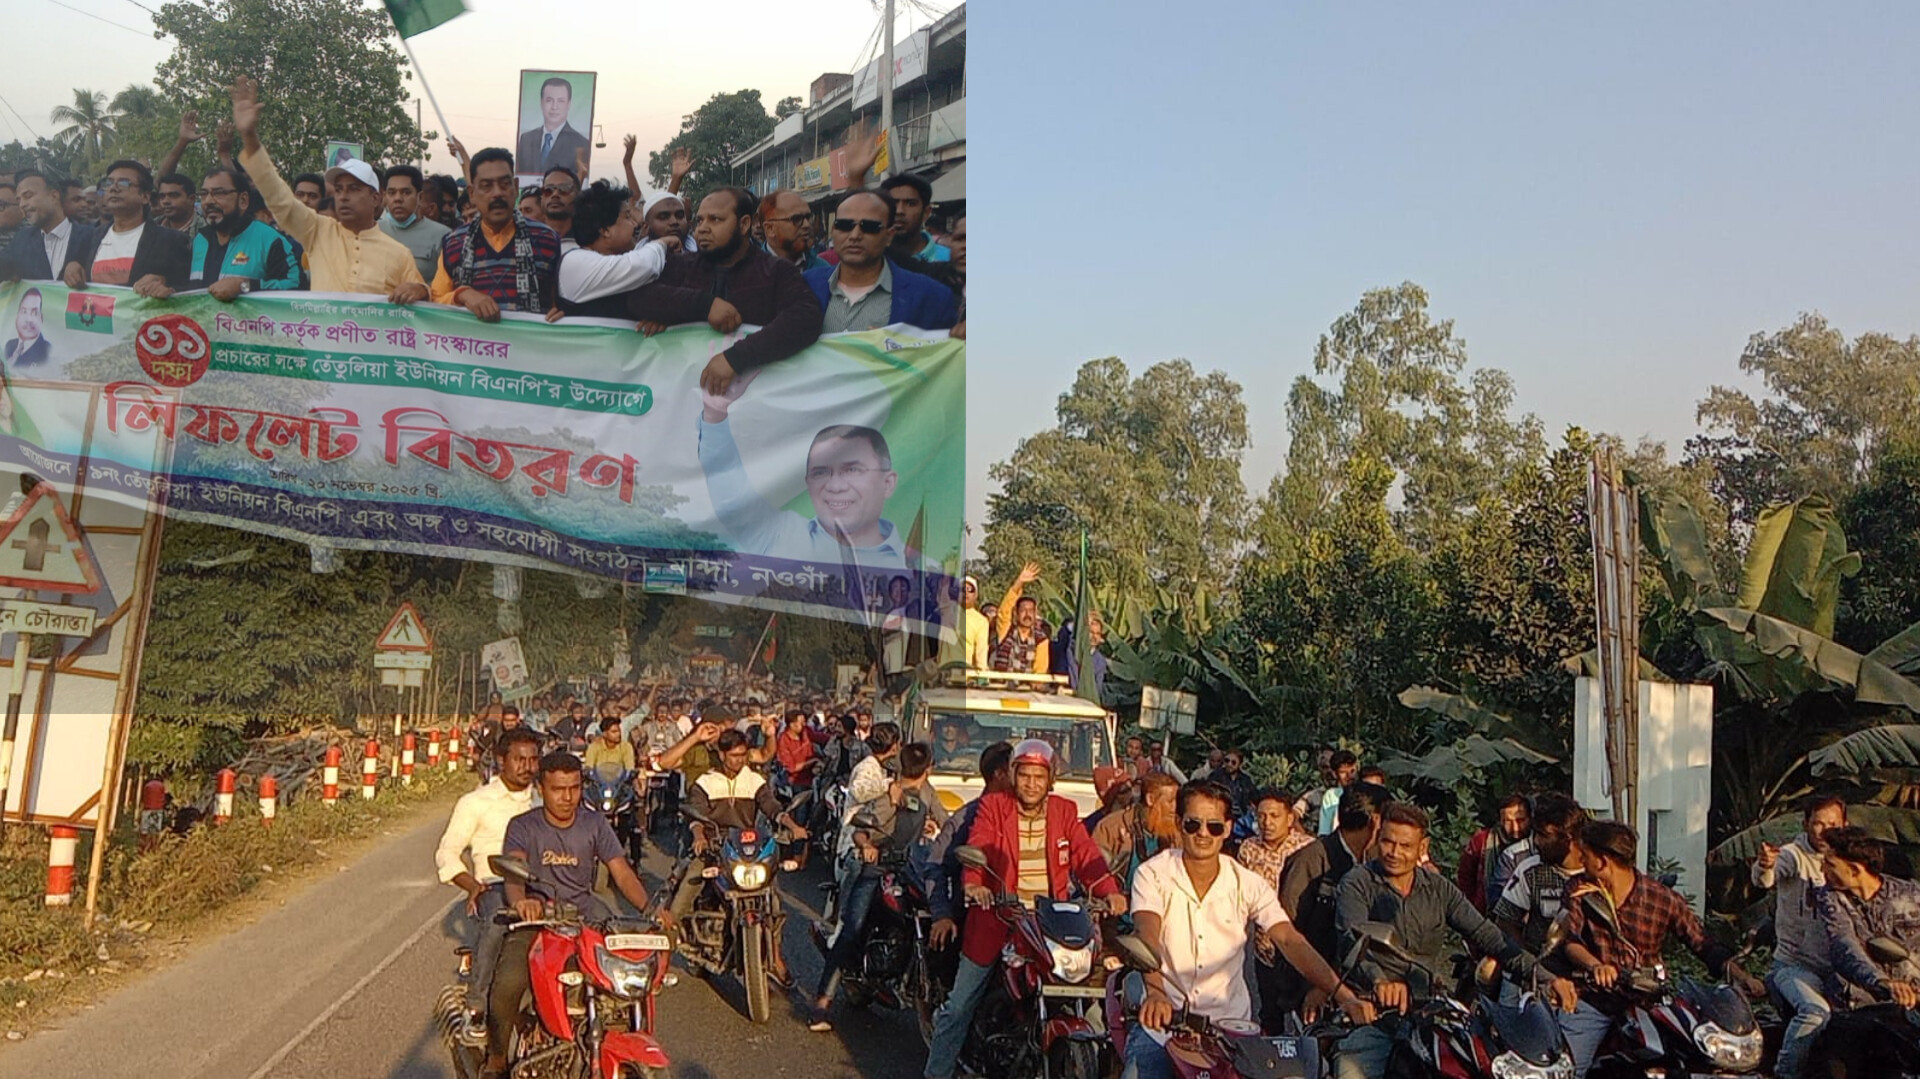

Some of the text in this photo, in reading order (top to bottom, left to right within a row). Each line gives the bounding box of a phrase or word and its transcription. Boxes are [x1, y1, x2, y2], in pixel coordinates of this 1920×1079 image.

[138, 323, 206, 360] ৩১
[215, 312, 511, 359] বিএনপি কর্তৃক প্রণীত রাষ্ট্র সংস্কারের
[151, 361, 193, 382] দফা
[215, 349, 270, 367] প্রচারের
[312, 354, 389, 380] তেঁতুলিয়া
[394, 359, 465, 388] ইউনিয়ন
[569, 380, 647, 409] উদ্যোগে
[103, 381, 640, 505] লিফলেট বিতরণ
[269, 468, 297, 484] তারিখ
[308, 478, 325, 490] ২০
[331, 480, 375, 493] নভেম্বর
[381, 483, 420, 496] ২০২৫
[19, 444, 72, 476] আয়োজনে
[90, 466, 122, 486] ৯নং
[124, 471, 192, 500] তেঁতুলিয়া
[199, 482, 271, 512] ইউনিয়ন
[274, 493, 344, 526] বিএনপি
[351, 510, 397, 530] এবং
[403, 511, 444, 533] অঙ্গ
[451, 517, 468, 533] ও
[474, 521, 563, 558] সহযোগী
[668, 556, 740, 588] মান্দা,
[749, 565, 828, 592] নওগাঁ
[25, 607, 88, 634] চৌরাস্তা
